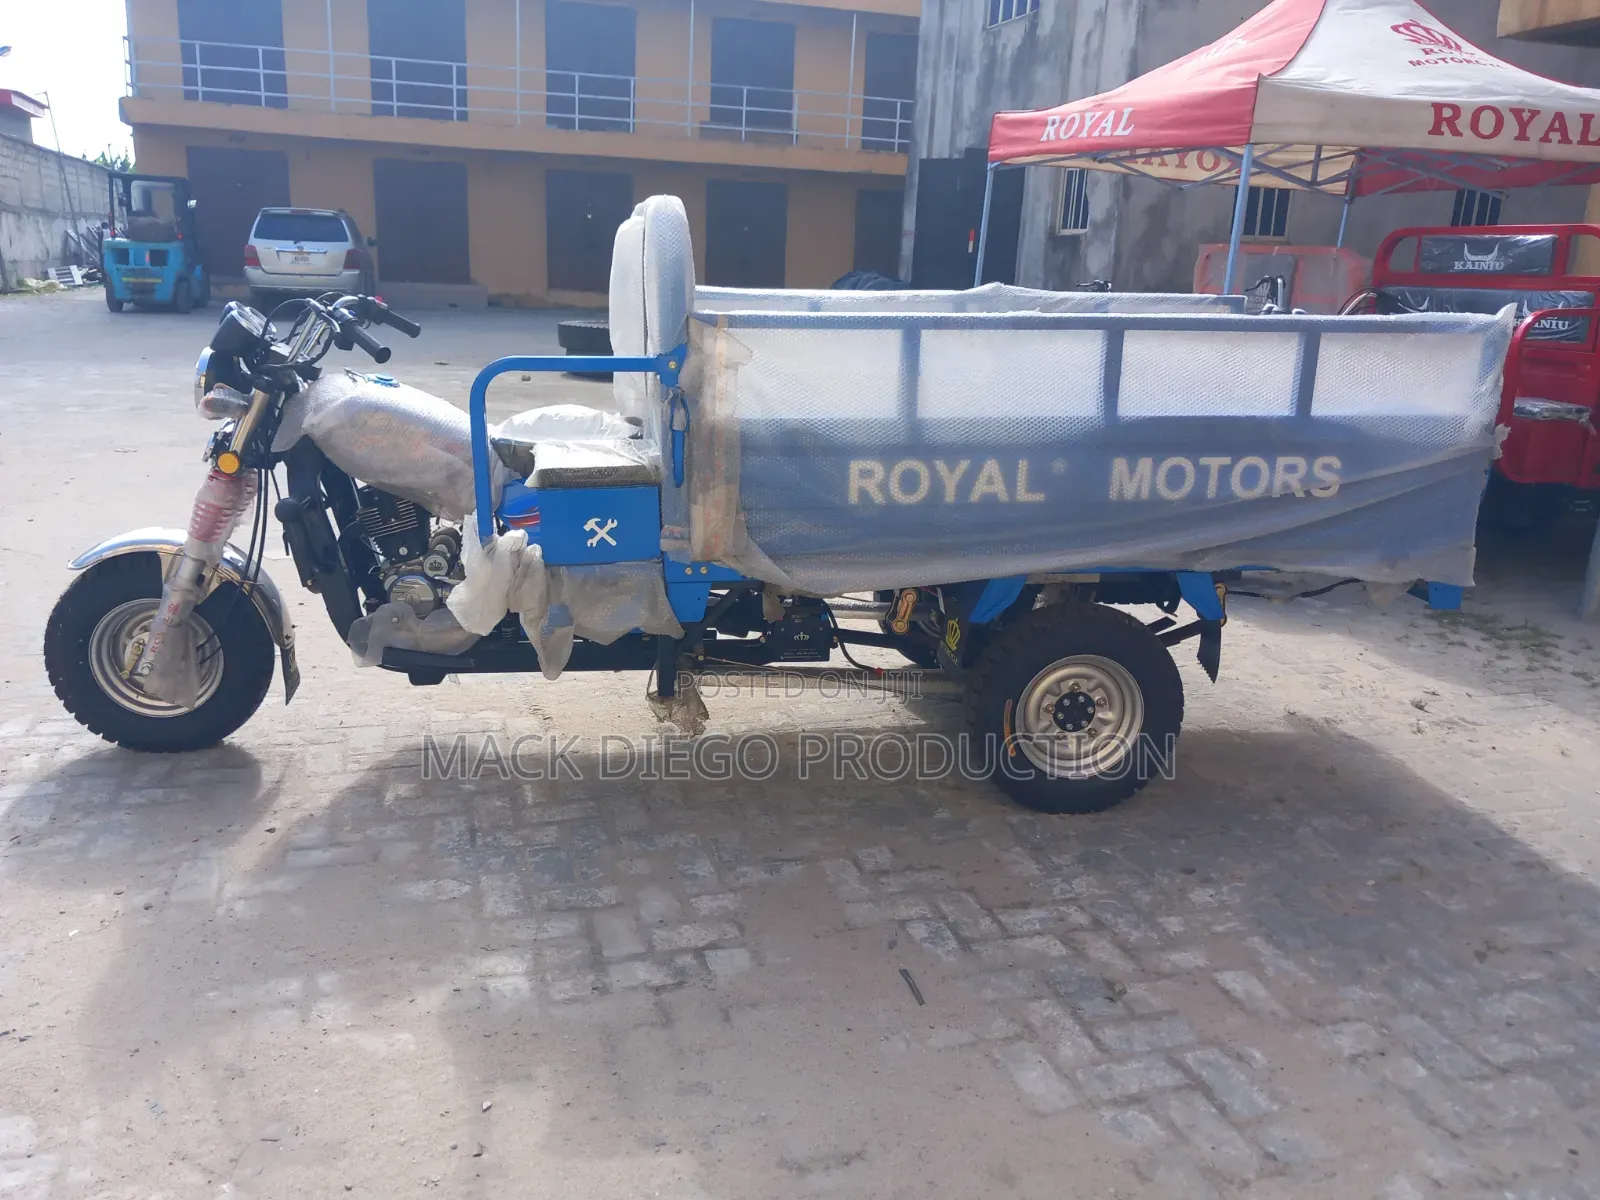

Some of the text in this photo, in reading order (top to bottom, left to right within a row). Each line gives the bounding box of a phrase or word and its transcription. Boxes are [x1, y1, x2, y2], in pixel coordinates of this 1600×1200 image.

[1040, 107, 1135, 142] ROYAL
[1428, 102, 1600, 146] ROYAL
[1454, 261, 1505, 271] KAINIU
[849, 456, 1342, 504] ROYAL MOTORS
